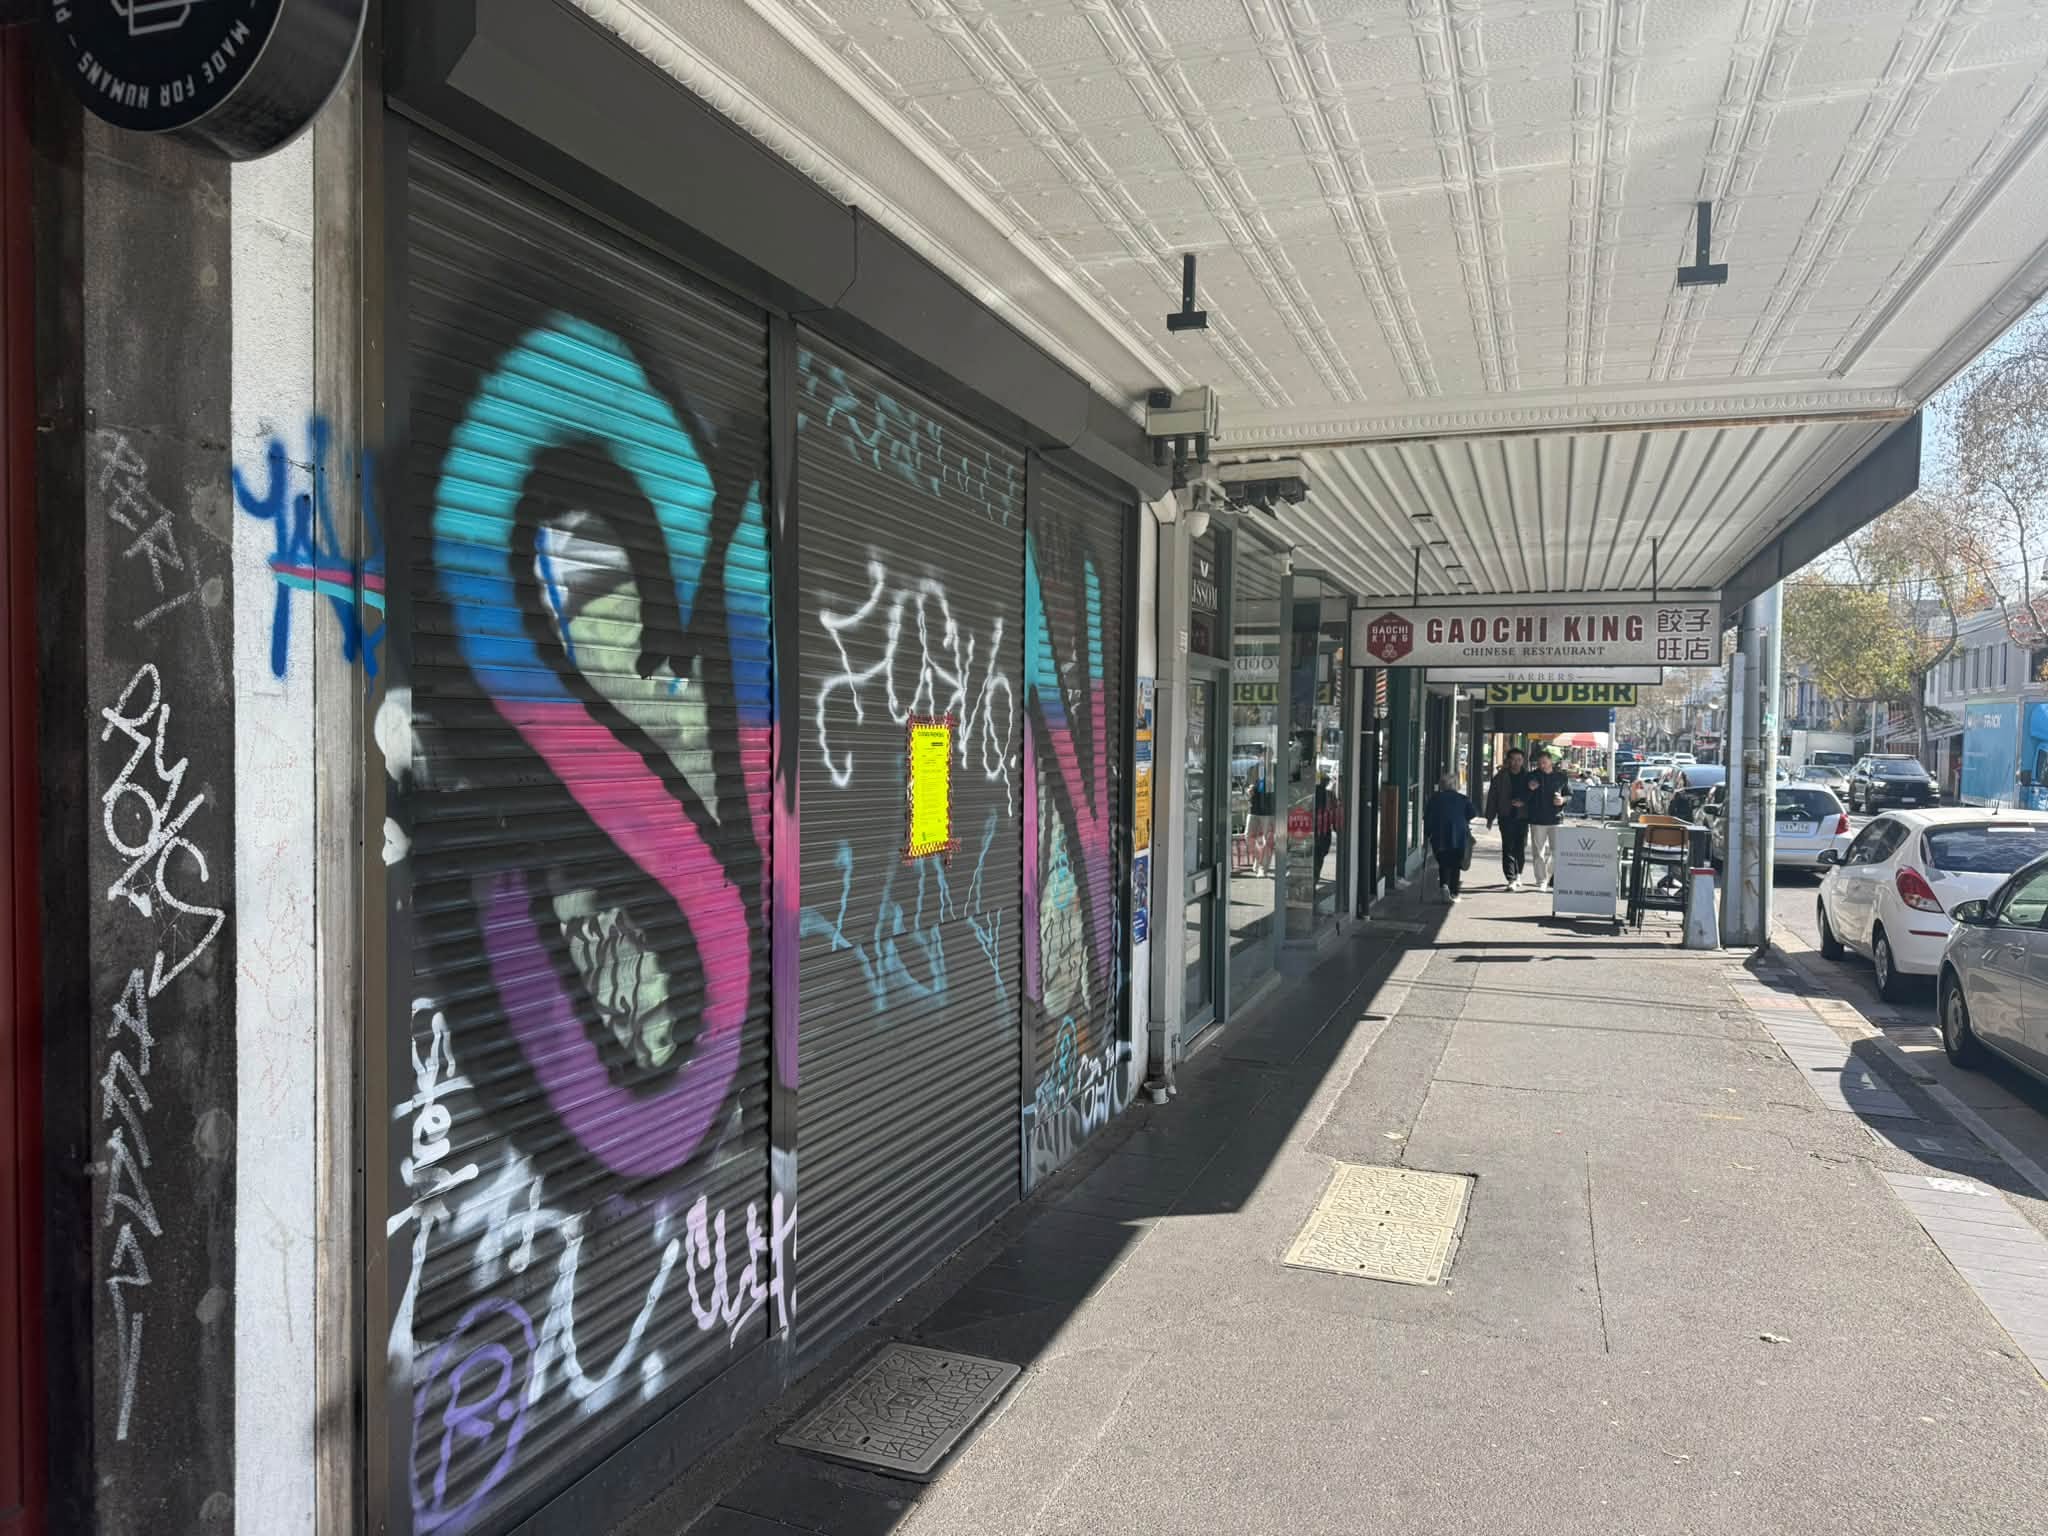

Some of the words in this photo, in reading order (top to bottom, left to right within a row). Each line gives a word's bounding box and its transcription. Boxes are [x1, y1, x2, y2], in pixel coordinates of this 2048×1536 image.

[201, 19, 250, 84] MADE
[77, 52, 150, 110] HUMANS
[159, 74, 196, 107] FOR
[1426, 616, 1549, 644] GAOCHI
[1563, 614, 1644, 642] KING
[1656, 607, 1712, 633] 餃子
[1462, 647, 1516, 657] CHINESE
[1523, 646, 1606, 657] RESTAURANT
[1656, 636, 1712, 661] 旺店
[1507, 672, 1575, 682] BARBERS
[1490, 684, 1633, 702] SPUDBAR
